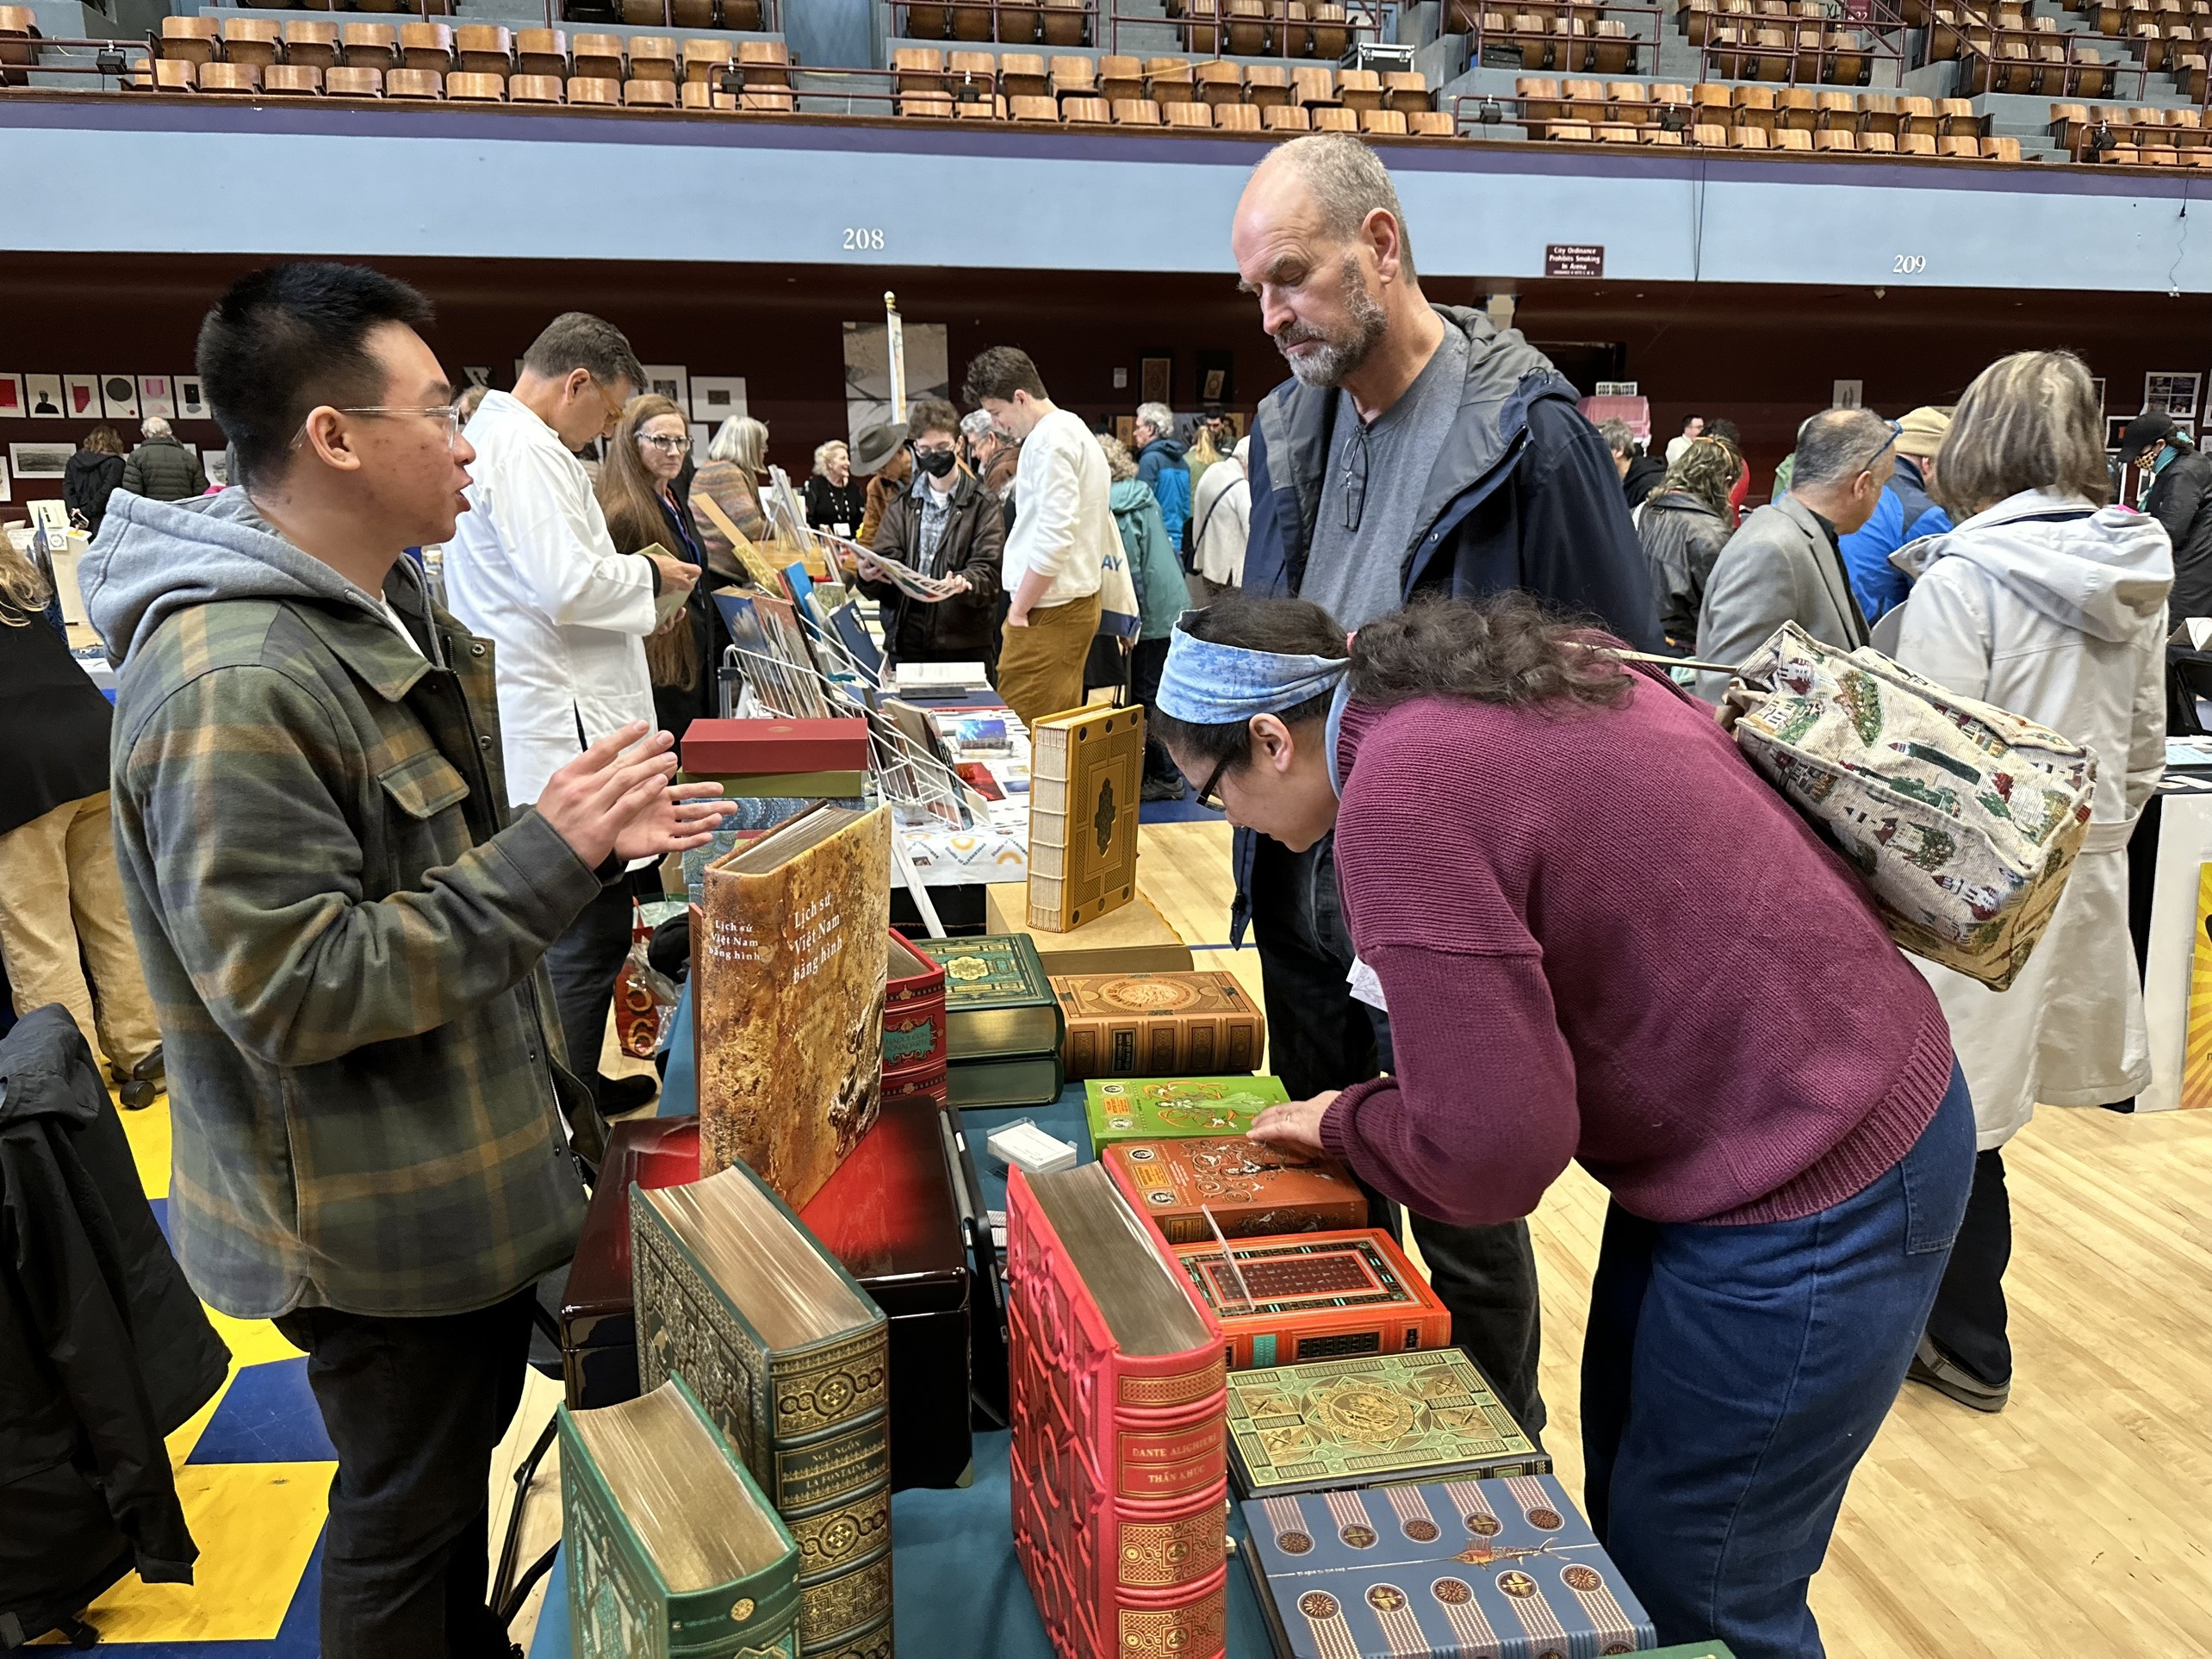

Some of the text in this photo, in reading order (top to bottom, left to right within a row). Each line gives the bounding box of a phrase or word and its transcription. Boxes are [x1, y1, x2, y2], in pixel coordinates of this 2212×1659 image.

[842, 228, 885, 250] 208
[1575, 255, 1600, 264] Smoking
[1892, 254, 1926, 274] 209
[794, 890, 832, 929] Lịch sử
[715, 920, 738, 932] Lịch
[794, 913, 840, 955] Việt Nam
[711, 932, 759, 947] Việt Nam
[820, 935, 843, 964] hình
[1132, 1433, 1217, 1457] DANTE ALIGHIERI
[806, 1461, 868, 1488] LA FONTAINE
